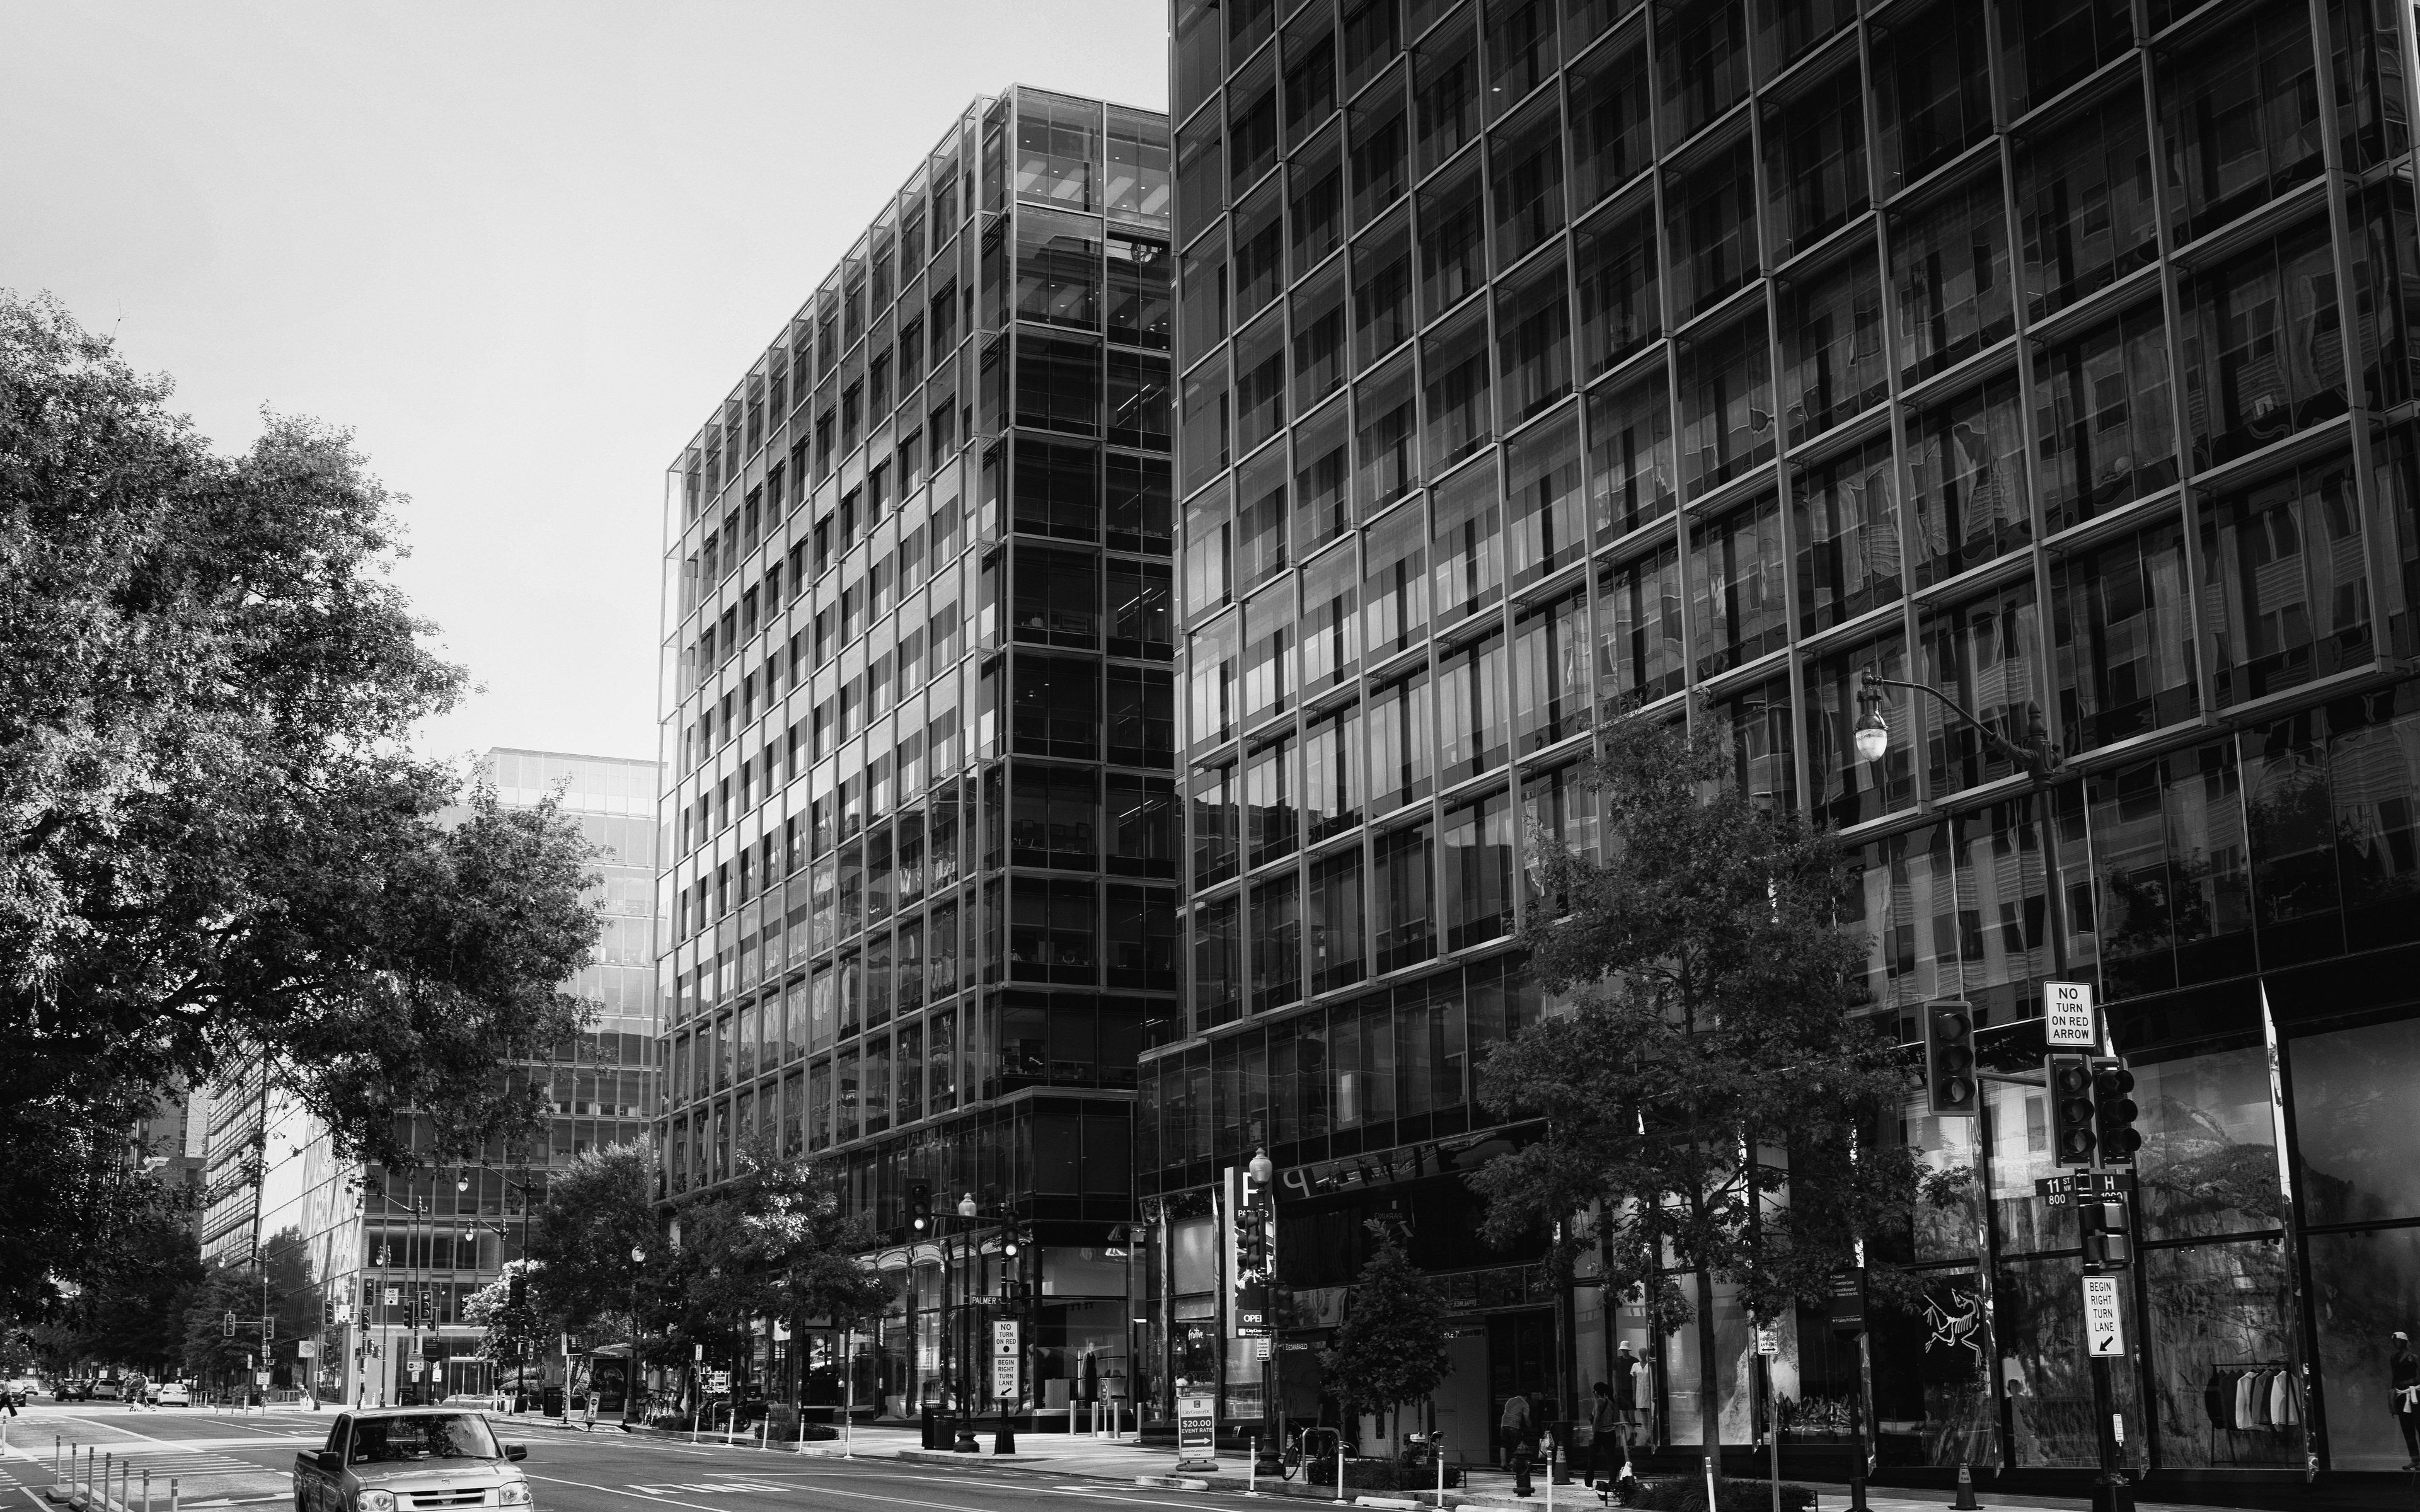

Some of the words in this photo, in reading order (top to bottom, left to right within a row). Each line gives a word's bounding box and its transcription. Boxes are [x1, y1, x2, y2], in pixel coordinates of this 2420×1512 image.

[2059, 987, 2078, 999] NO
[2056, 1003, 2083, 1012] TURN
[2052, 1016, 2066, 1025] ON
[2070, 1017, 2089, 1026] RED
[2053, 1029, 2089, 1039] ARROW
[2047, 1179, 2059, 1193] 11
[2104, 1176, 2114, 1189] H
[2049, 1194, 2066, 1205] 800
[2090, 1282, 2111, 1292] BEGIN
[972, 1296, 996, 1305] PALMER
[2090, 1295, 2112, 1305] RIGHT
[1243, 1314, 1262, 1322] OPE
[2093, 1309, 2113, 1318] TURN
[2094, 1322, 2114, 1332] LANE
[1182, 1419, 1211, 1428] $20.00
